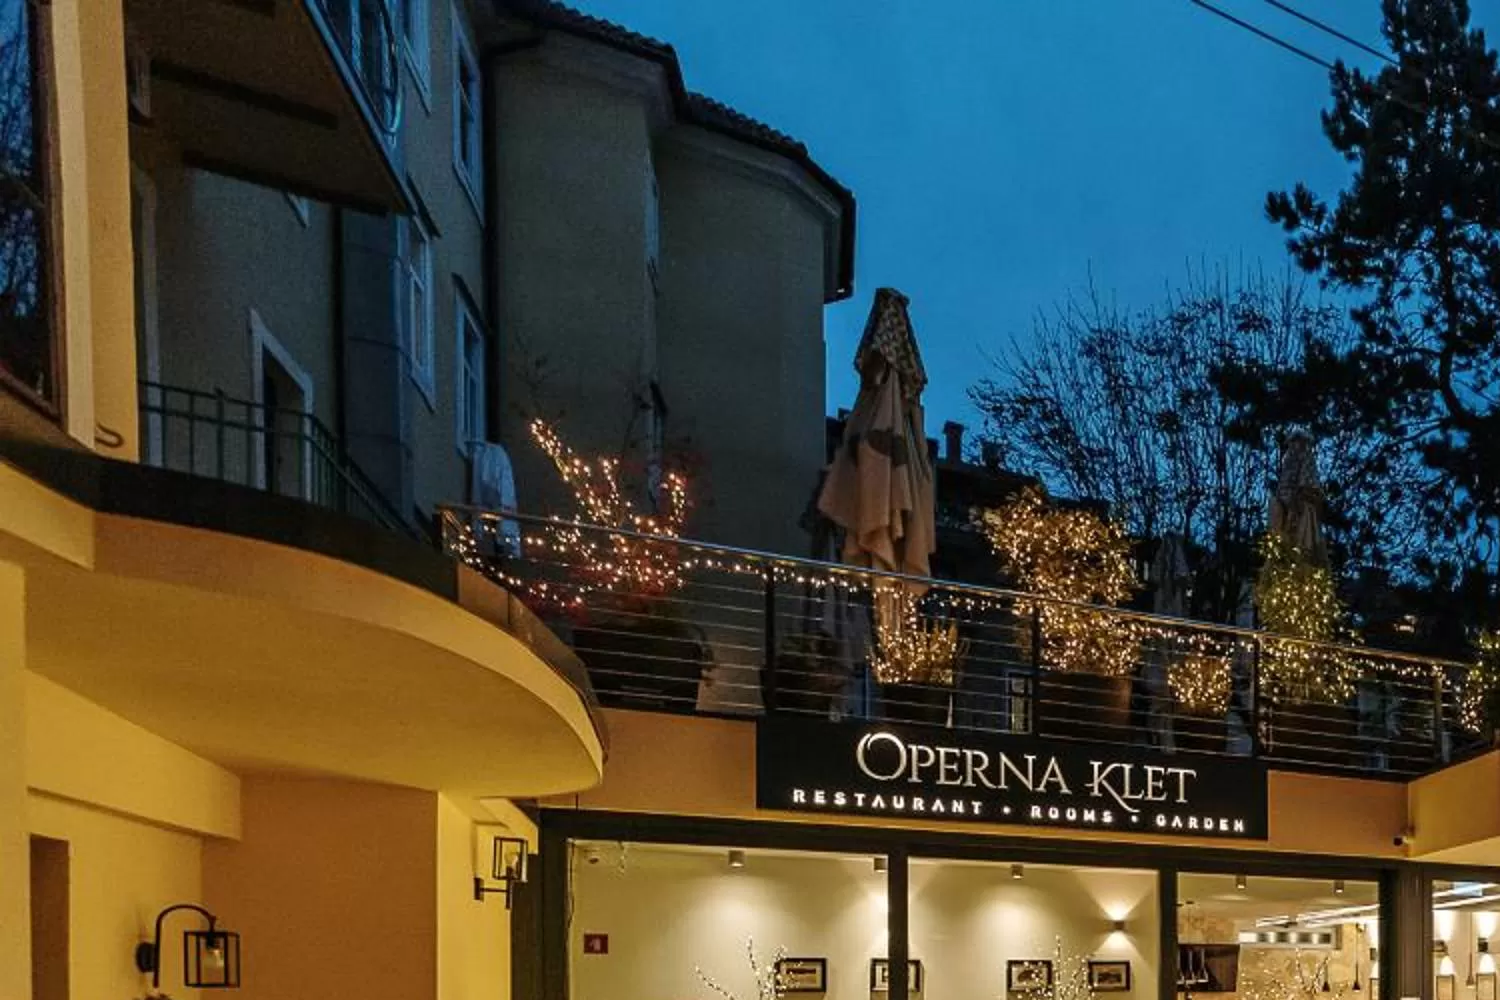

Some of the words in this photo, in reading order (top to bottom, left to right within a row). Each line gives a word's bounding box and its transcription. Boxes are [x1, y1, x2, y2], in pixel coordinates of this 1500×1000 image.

[855, 732, 1073, 795] OPERNA
[1085, 760, 1197, 813] KLET
[792, 788, 984, 815] RESTAURANT
[1030, 804, 1113, 824] ROOMS
[1155, 813, 1245, 833] GARDEN
